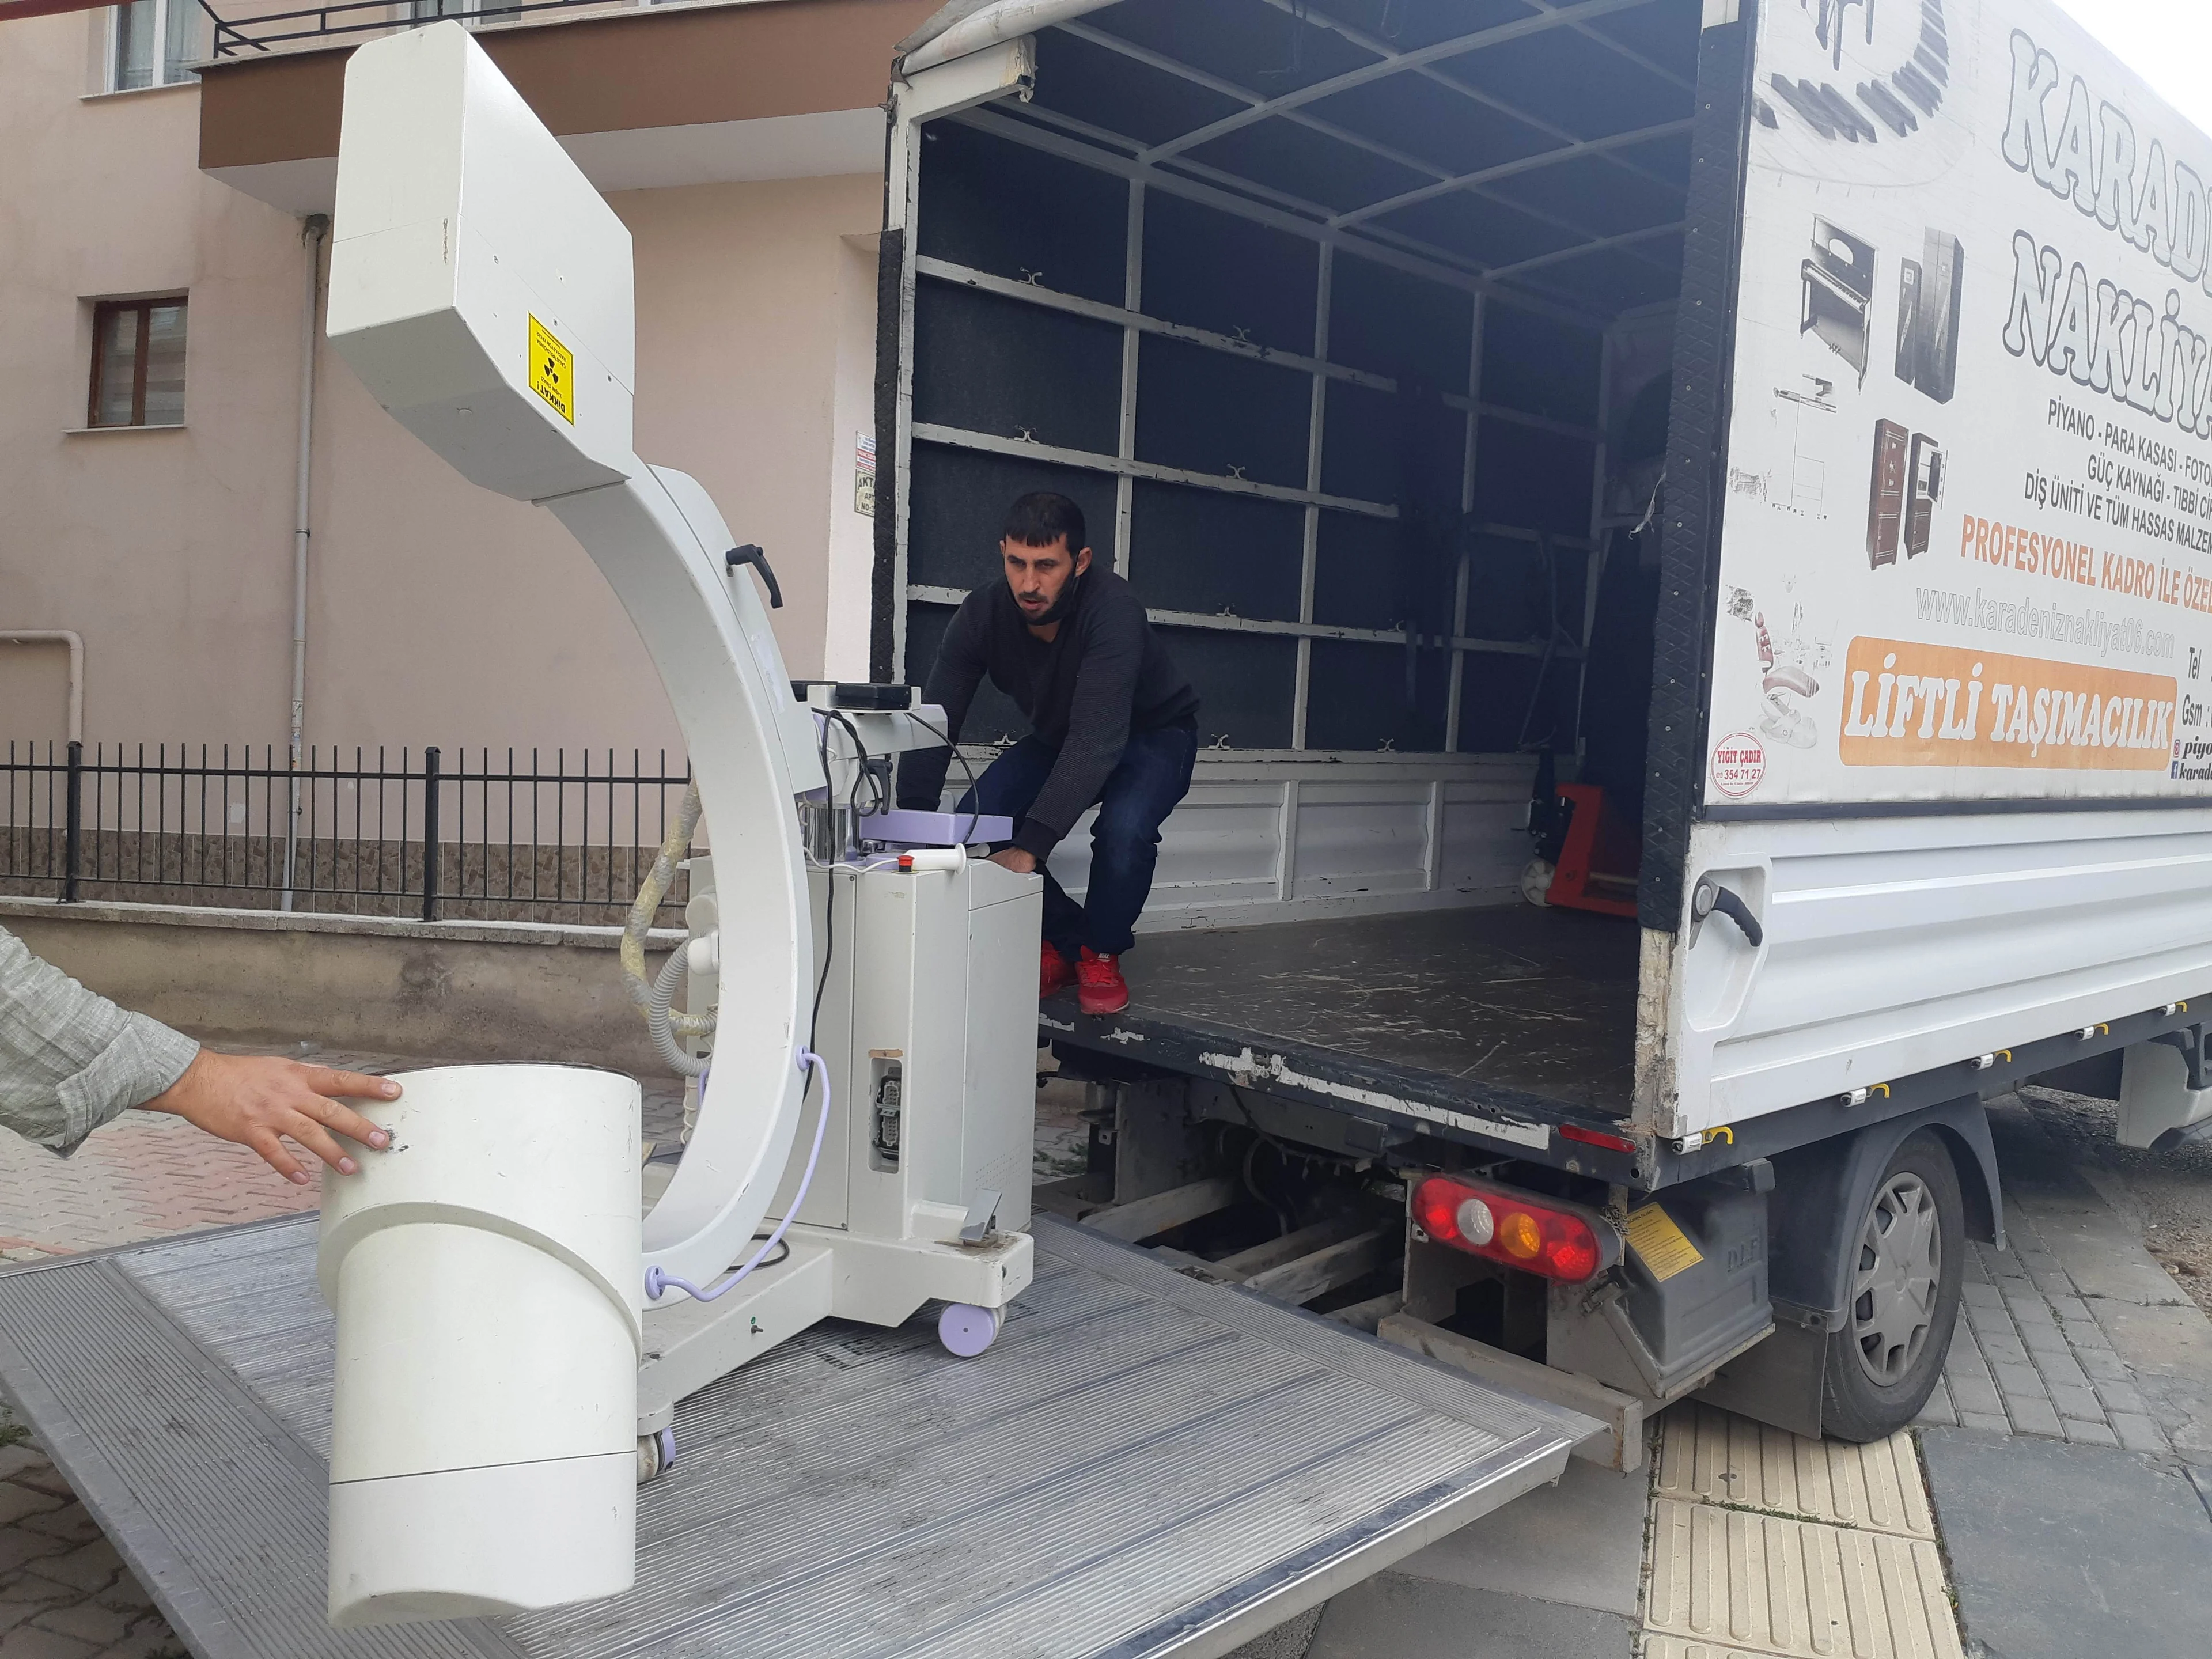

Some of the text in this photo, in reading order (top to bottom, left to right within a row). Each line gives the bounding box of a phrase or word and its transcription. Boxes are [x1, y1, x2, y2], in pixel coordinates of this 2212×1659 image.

[2001, 28, 2212, 298] KARAD
[2048, 395, 2095, 441] PİYANO
[2105, 422, 2135, 457] PARA
[2138, 435, 2177, 473] KASASI
[2185, 454, 2212, 487] FOTO
[858, 476, 876, 490] AKT
[2024, 468, 2047, 510] DİŞ
[2051, 474, 2084, 515] ÜNİTİ
[2087, 492, 2103, 520] VE
[2106, 495, 2130, 529] TÜM
[2131, 506, 2174, 542] HASSAS
[2088, 452, 2113, 491] GÜÇ
[2116, 464, 2164, 503] KAYNAĞI
[2173, 485, 2199, 516] TIBBİ
[1960, 514, 2096, 587] PROFESYONEL
[2101, 551, 2155, 600] KADRO
[2158, 557, 2181, 605] İLE
[1916, 587, 2175, 658] www.karadeniznakliyat06.com
[2188, 647, 2202, 680] Tel
[1844, 652, 2173, 758] LİFTLİ TAŞIMACILIK
[2182, 694, 2203, 727] Gsm
[1717, 747, 1761, 767] YİĞİT ÇADIR
[1724, 769, 1738, 780] 354
[1740, 769, 1749, 779] 71
[1752, 768, 1761, 779] 27
